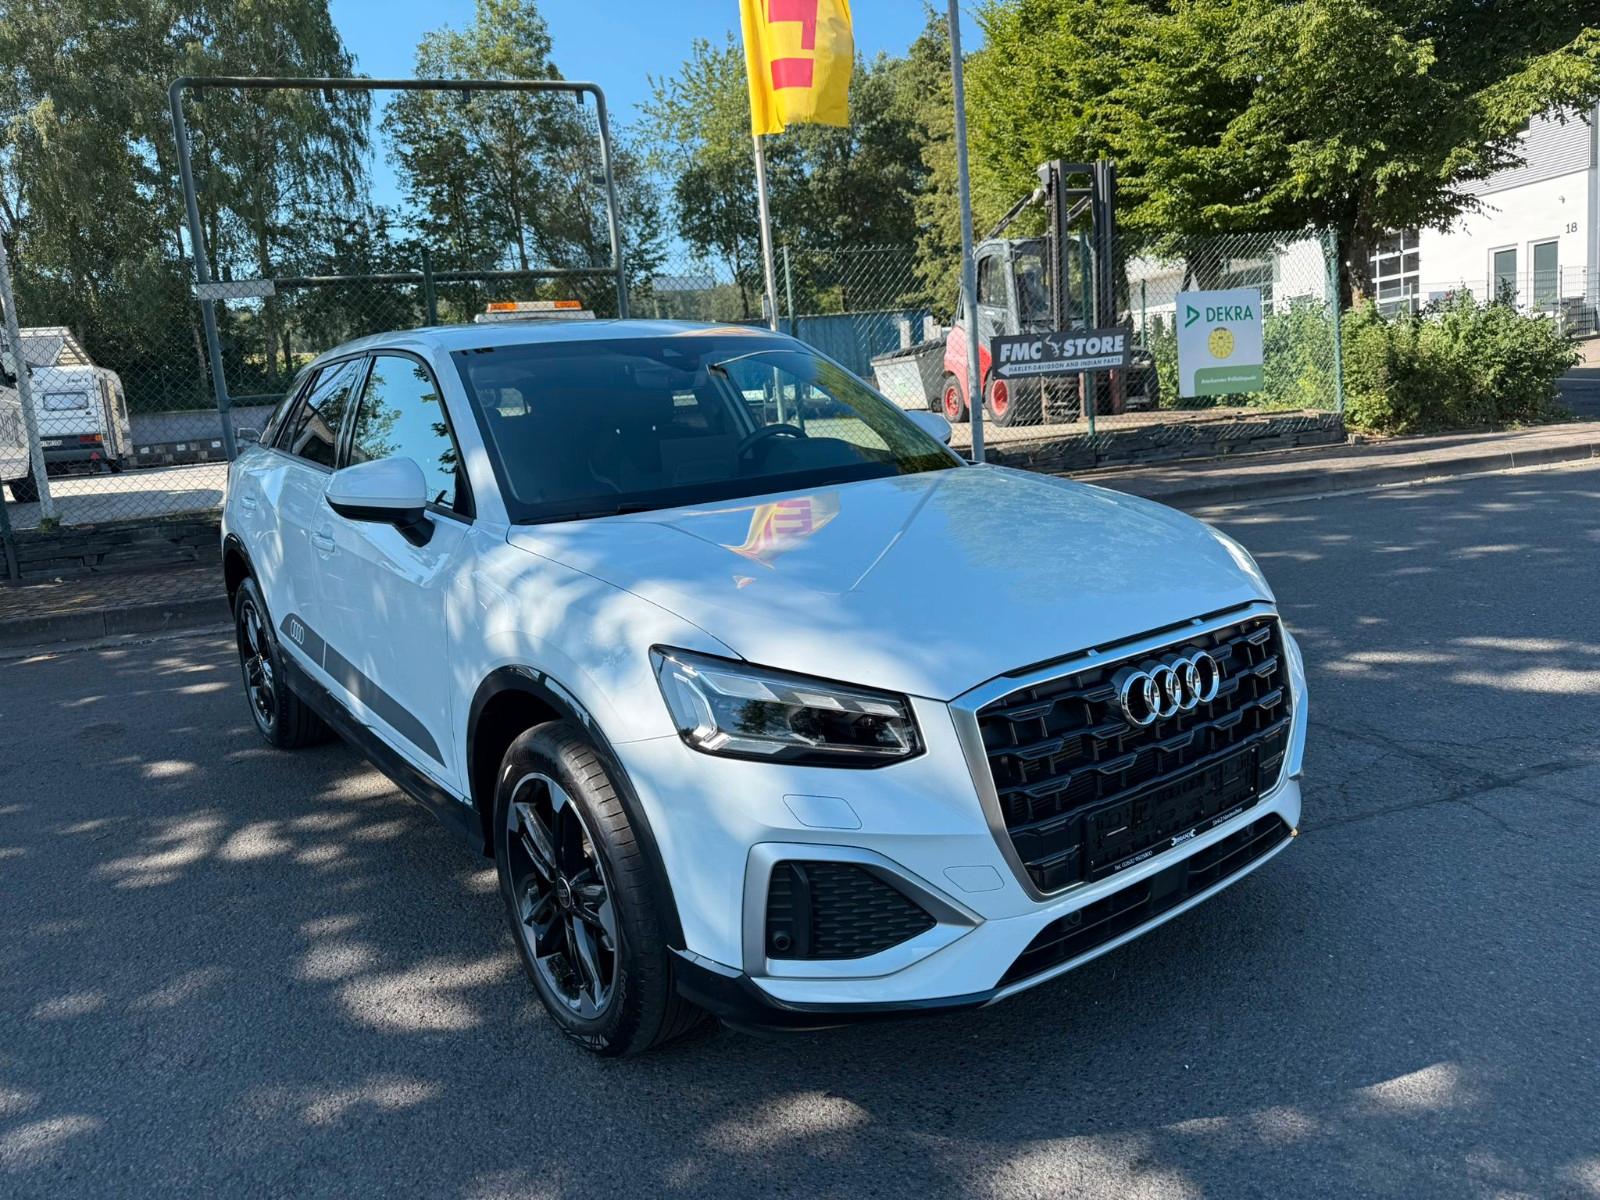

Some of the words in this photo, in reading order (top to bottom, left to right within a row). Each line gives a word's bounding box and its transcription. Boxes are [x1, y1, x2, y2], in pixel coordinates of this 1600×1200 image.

[1565, 222, 1577, 234] 18
[1206, 305, 1254, 322] DEKRA
[1000, 341, 1042, 362] FMC
[1063, 335, 1125, 357] STORE
[1008, 361, 1064, 373] HARLEY-DAVIDSON
[1066, 360, 1079, 368] AND
[1080, 358, 1102, 367] INDIAN
[1103, 356, 1121, 365] PARTS
